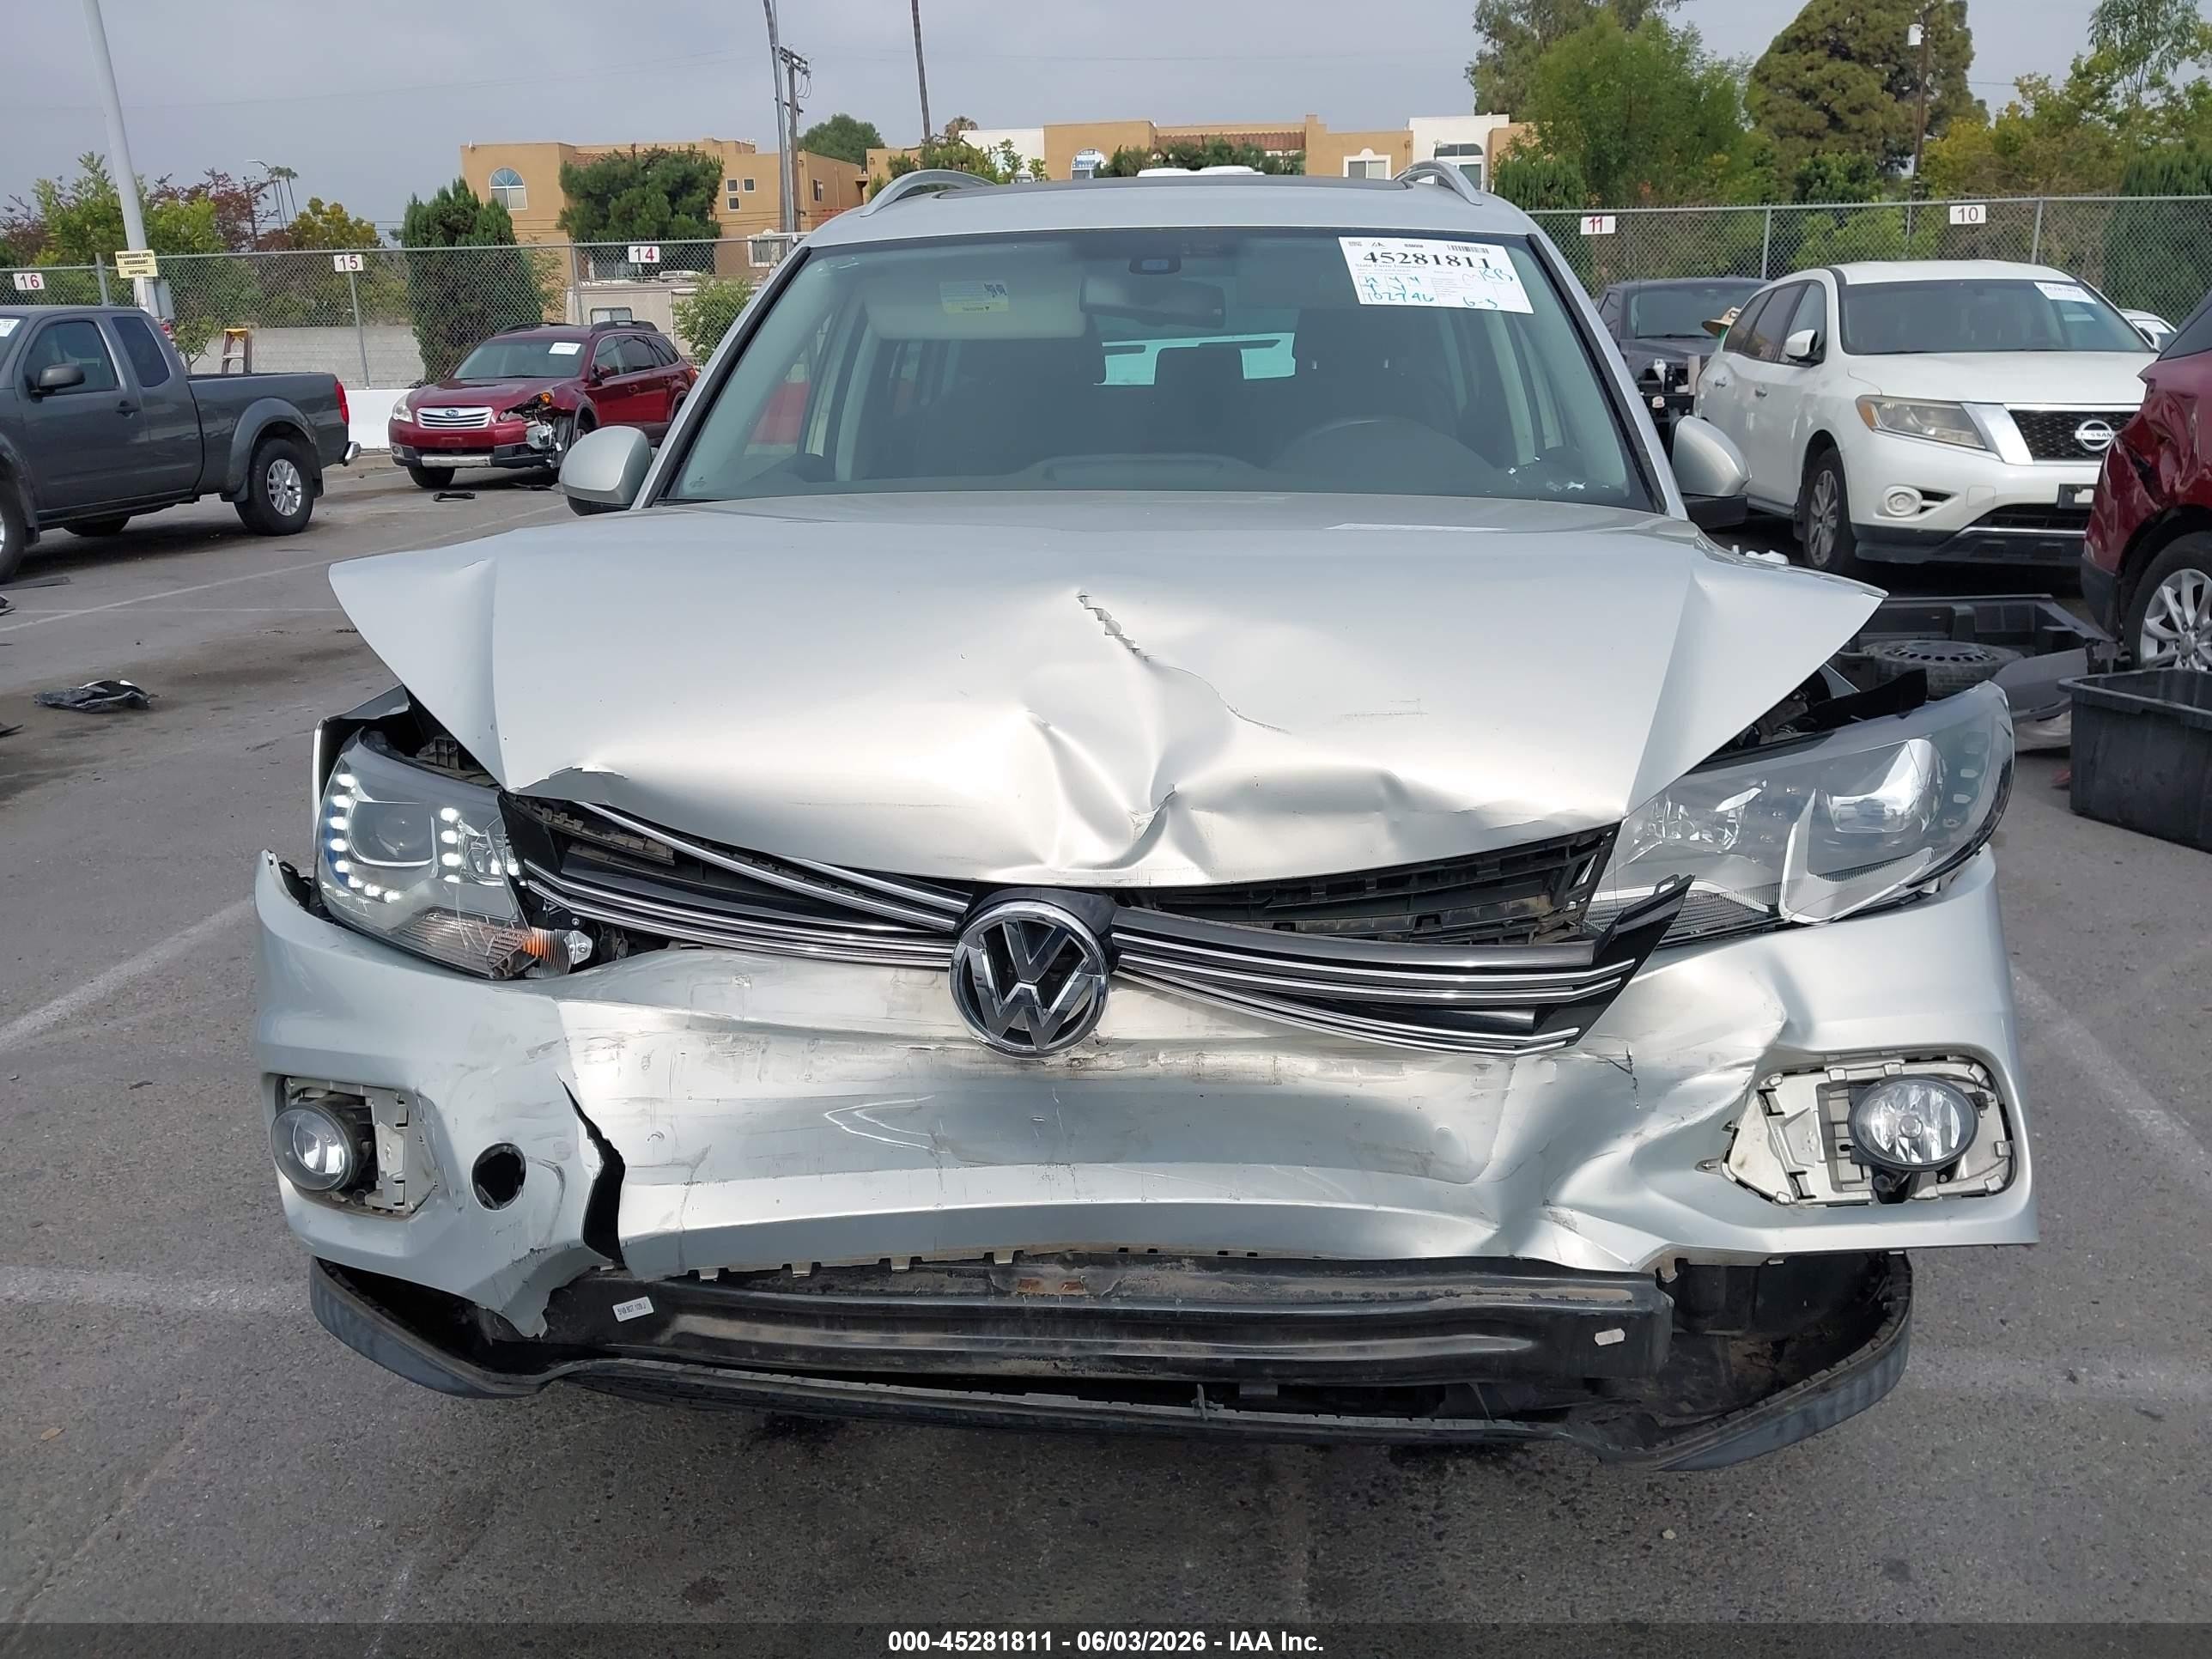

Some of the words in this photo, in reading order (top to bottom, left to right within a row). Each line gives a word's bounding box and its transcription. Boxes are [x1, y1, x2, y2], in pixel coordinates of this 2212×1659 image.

[1958, 206, 1978, 222] 10
[1589, 216, 1602, 233] 11
[635, 246, 654, 262] 14
[1363, 252, 1492, 270] 45281811
[339, 255, 358, 270] 15
[20, 274, 40, 289] 16
